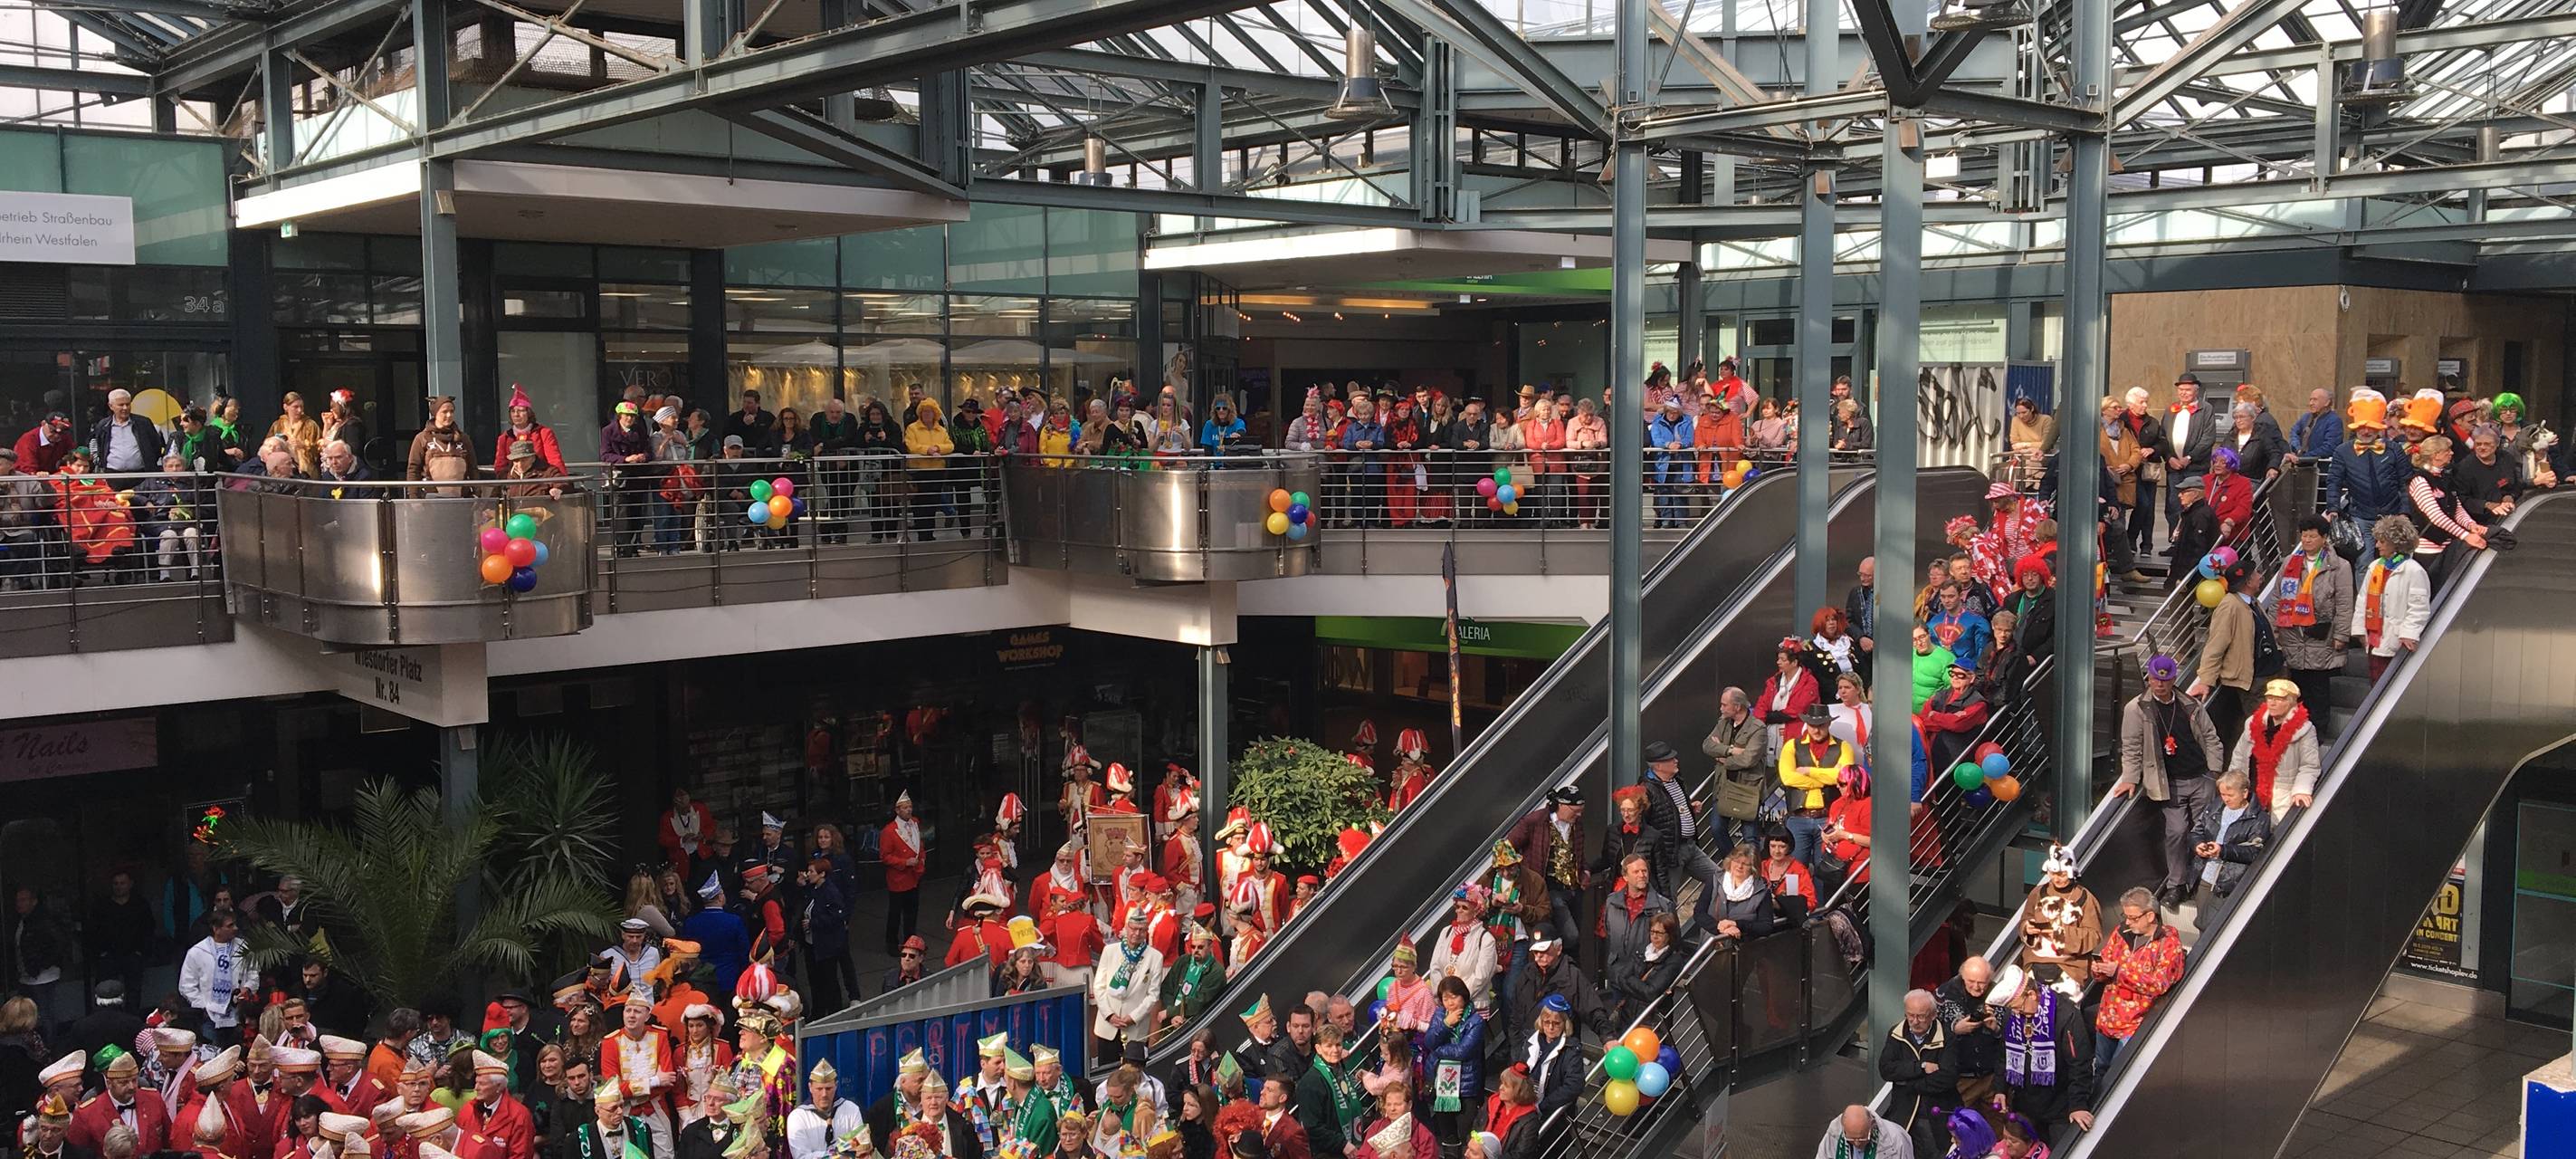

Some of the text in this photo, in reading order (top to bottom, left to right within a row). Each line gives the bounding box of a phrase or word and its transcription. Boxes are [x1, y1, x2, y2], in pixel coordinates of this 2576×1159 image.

[43, 211, 112, 226] Straßenbau
[35, 234, 98, 247] Westfalen
[184, 295, 209, 313] 34
[997, 644, 1064, 663] WORKSHOP
[400, 654, 423, 683] Platz
[375, 676, 400, 704] Nr. 84
[14, 730, 89, 761] Nails
[2426, 929, 2459, 943] CONCERT
